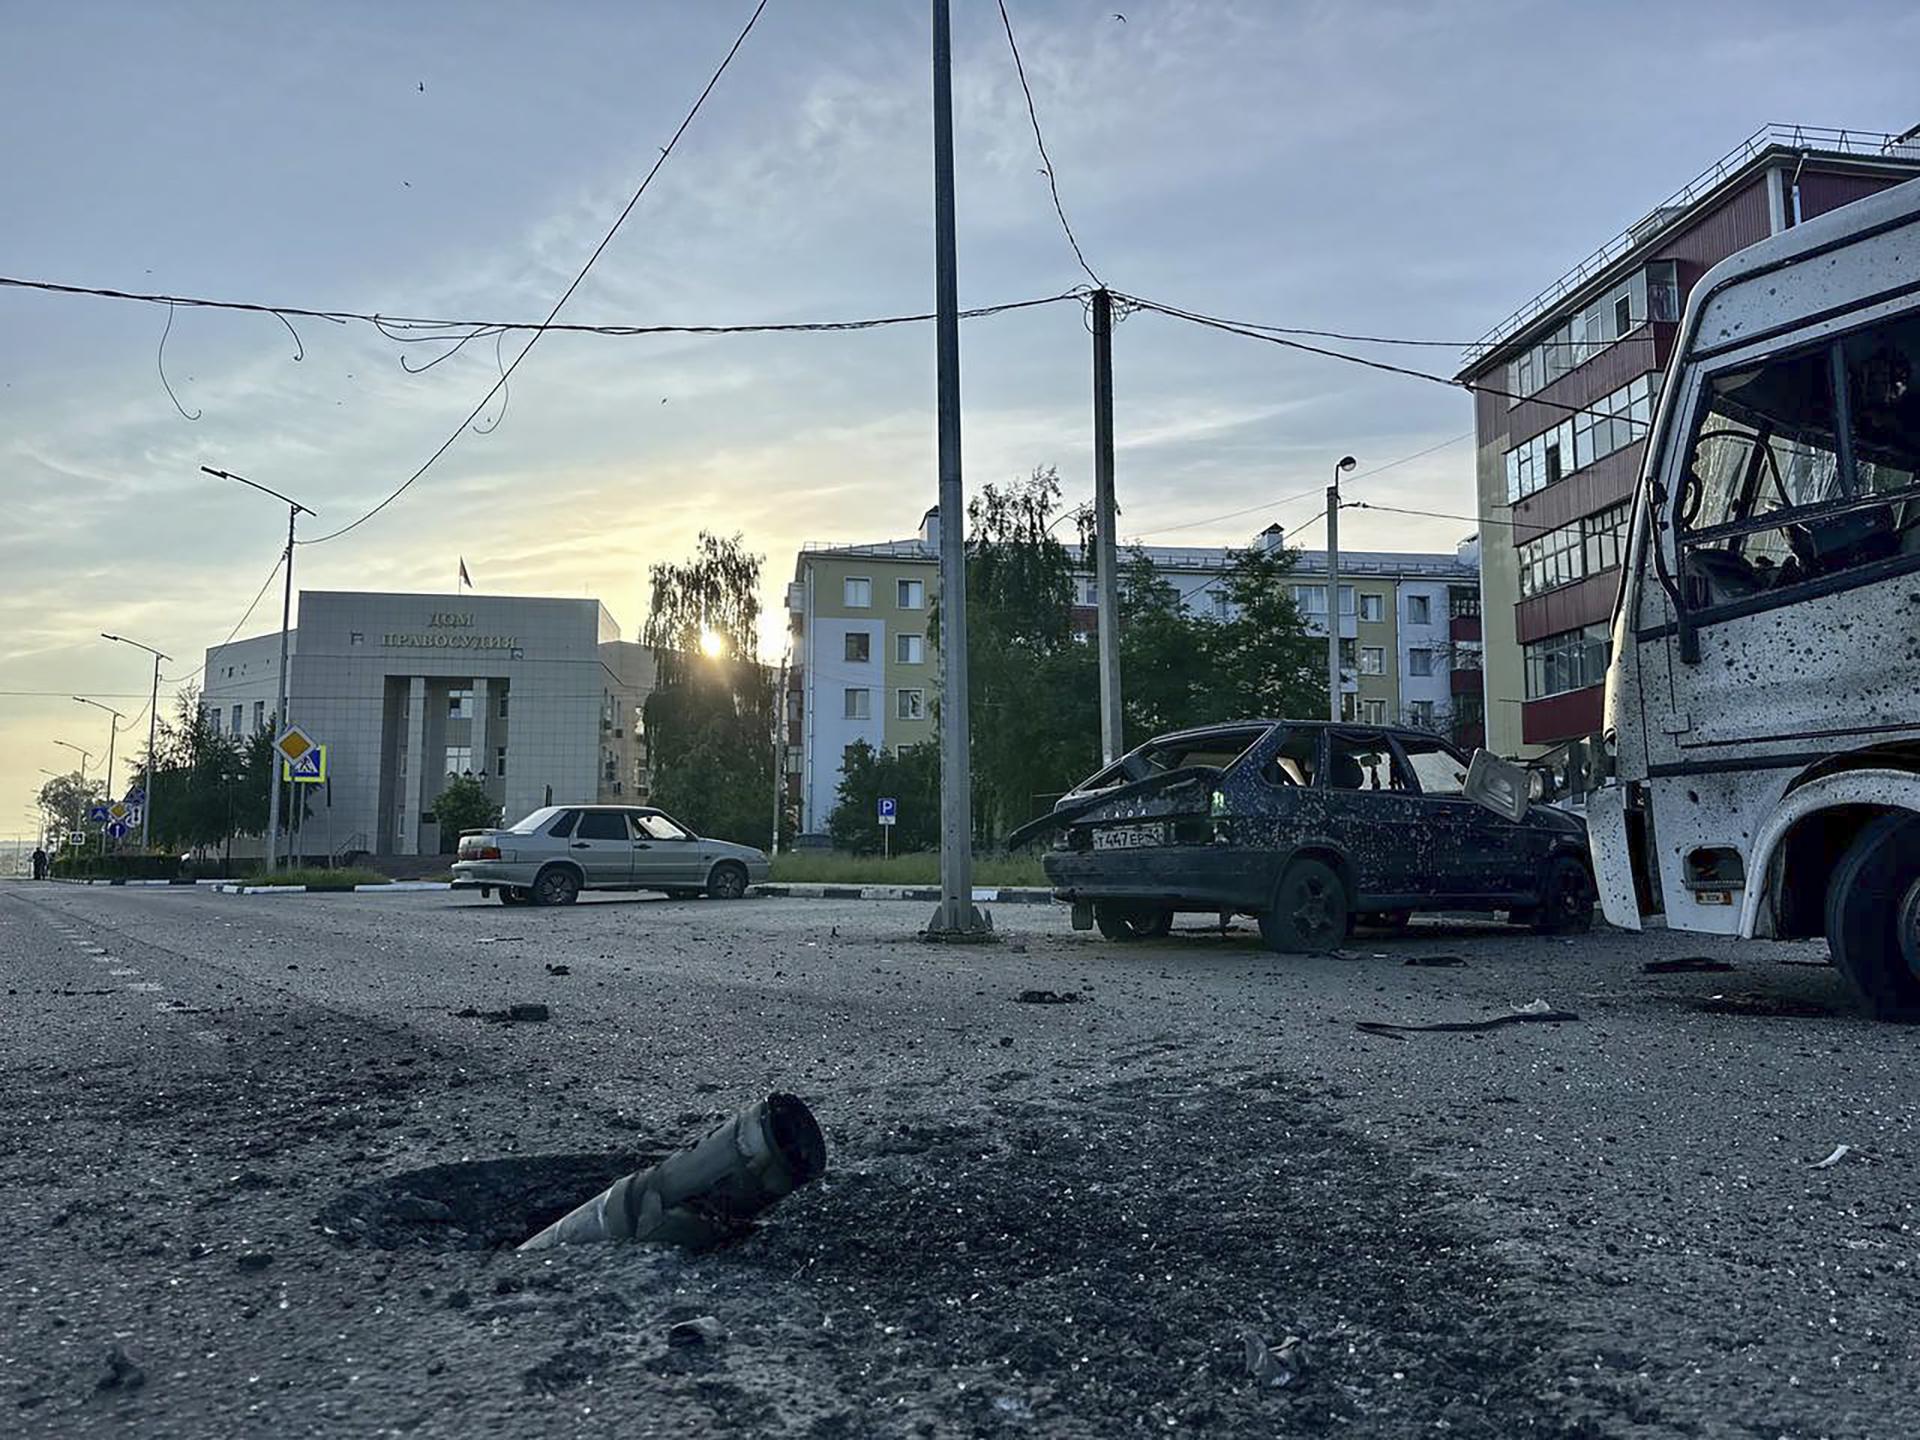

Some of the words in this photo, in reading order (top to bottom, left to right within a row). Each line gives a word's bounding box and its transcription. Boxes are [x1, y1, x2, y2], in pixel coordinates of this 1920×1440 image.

[429, 612, 473, 627] ДОМ
[382, 634, 517, 649] ПРАВОСУДИЯ
[1103, 808, 1147, 819] LADA
